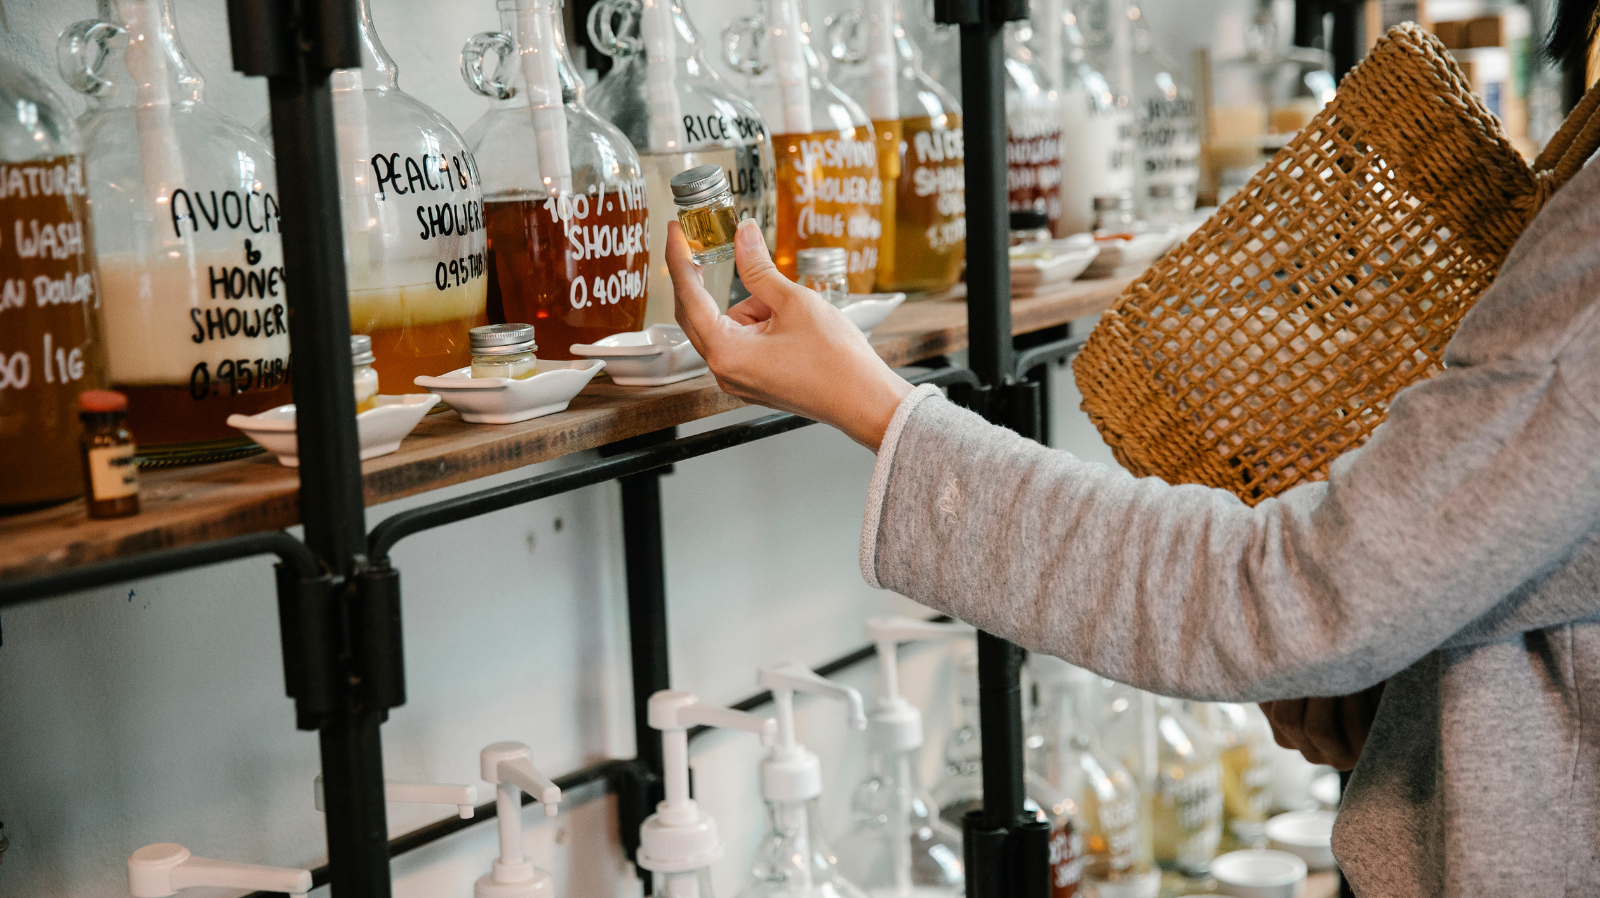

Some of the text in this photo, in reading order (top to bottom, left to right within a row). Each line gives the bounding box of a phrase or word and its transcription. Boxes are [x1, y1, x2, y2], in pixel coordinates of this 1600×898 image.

[683, 115, 731, 143] RICE
[371, 152, 454, 201] PEACH
[15, 217, 84, 258] WASH
[416, 200, 481, 240] SHOWER
[568, 222, 643, 261] SHOWER
[190, 303, 287, 344] SHOWER
